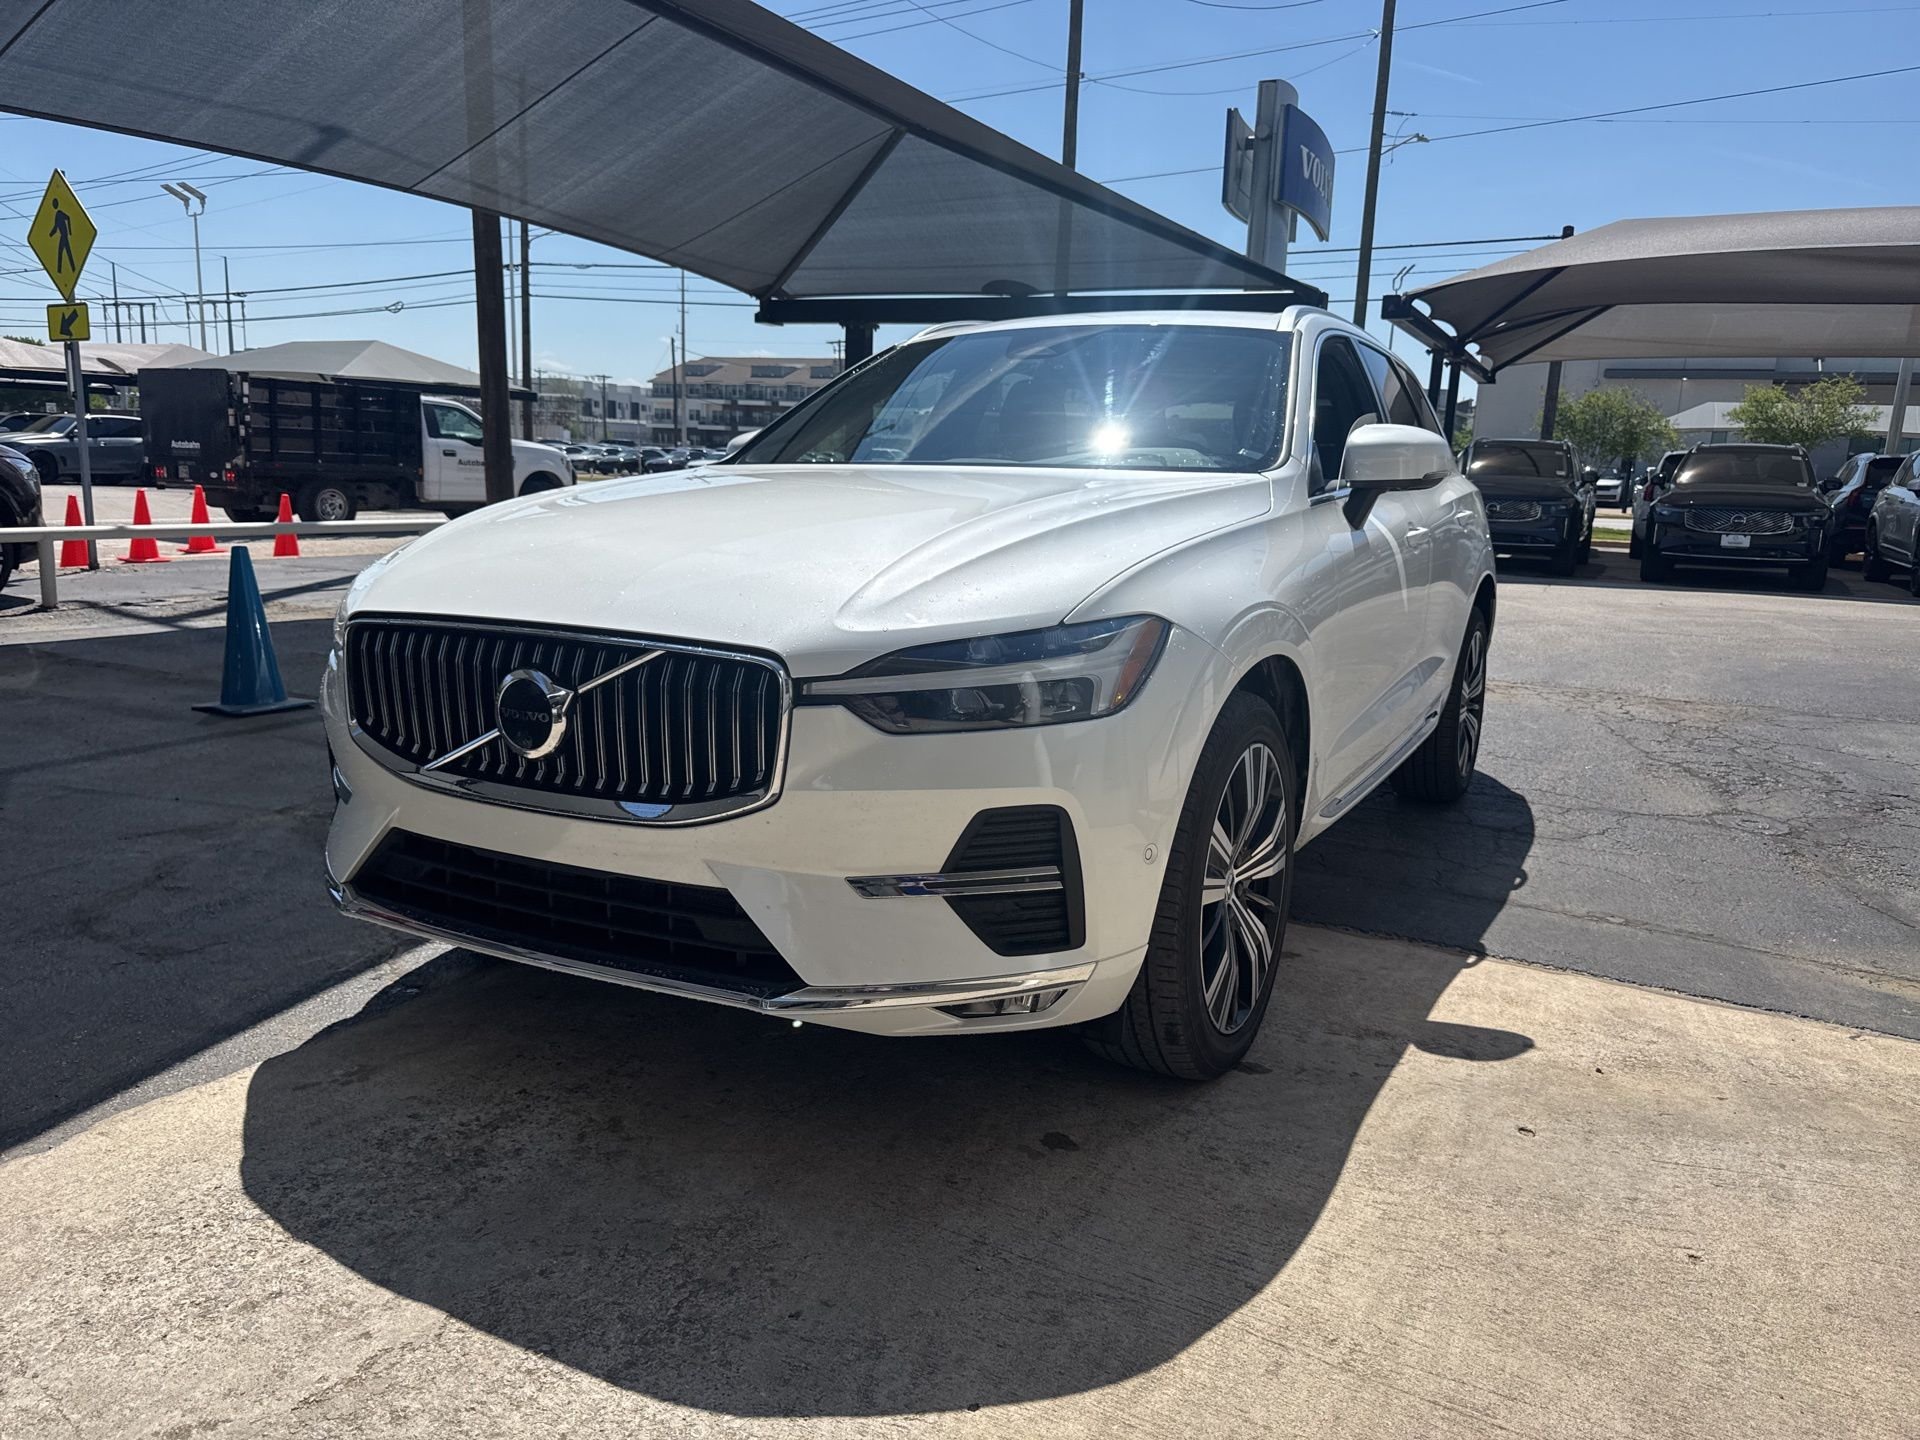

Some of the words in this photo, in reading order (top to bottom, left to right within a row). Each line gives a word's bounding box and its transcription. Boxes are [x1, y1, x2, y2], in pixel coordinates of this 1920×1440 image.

[1300, 144, 1331, 208] VOLV
[171, 440, 200, 449] Autobahn
[458, 458, 485, 466] Autoba
[501, 707, 550, 722] VOLVO
